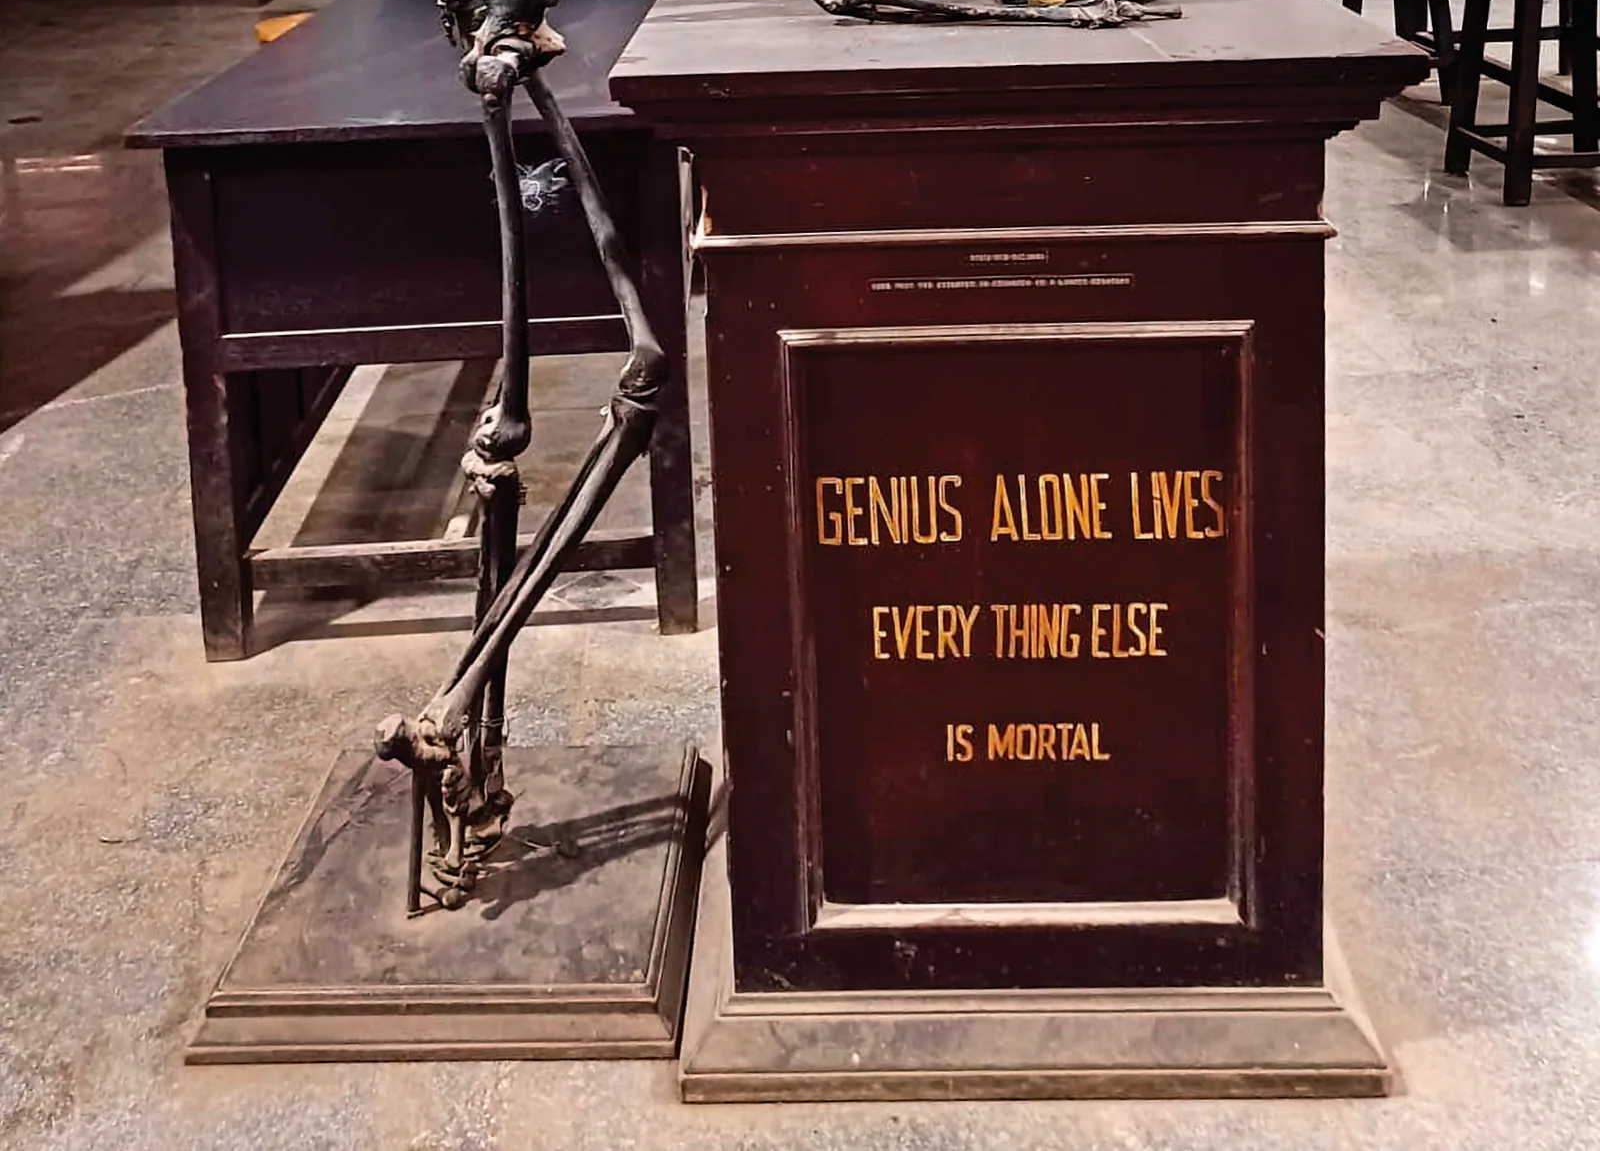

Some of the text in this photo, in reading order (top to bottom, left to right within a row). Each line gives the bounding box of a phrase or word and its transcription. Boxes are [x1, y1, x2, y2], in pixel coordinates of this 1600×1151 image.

[815, 470, 1225, 546] GENIUS ALONE LIVES
[872, 603, 1169, 660] EVERY THING ELSE
[946, 722, 1112, 762] IS MORTAL
